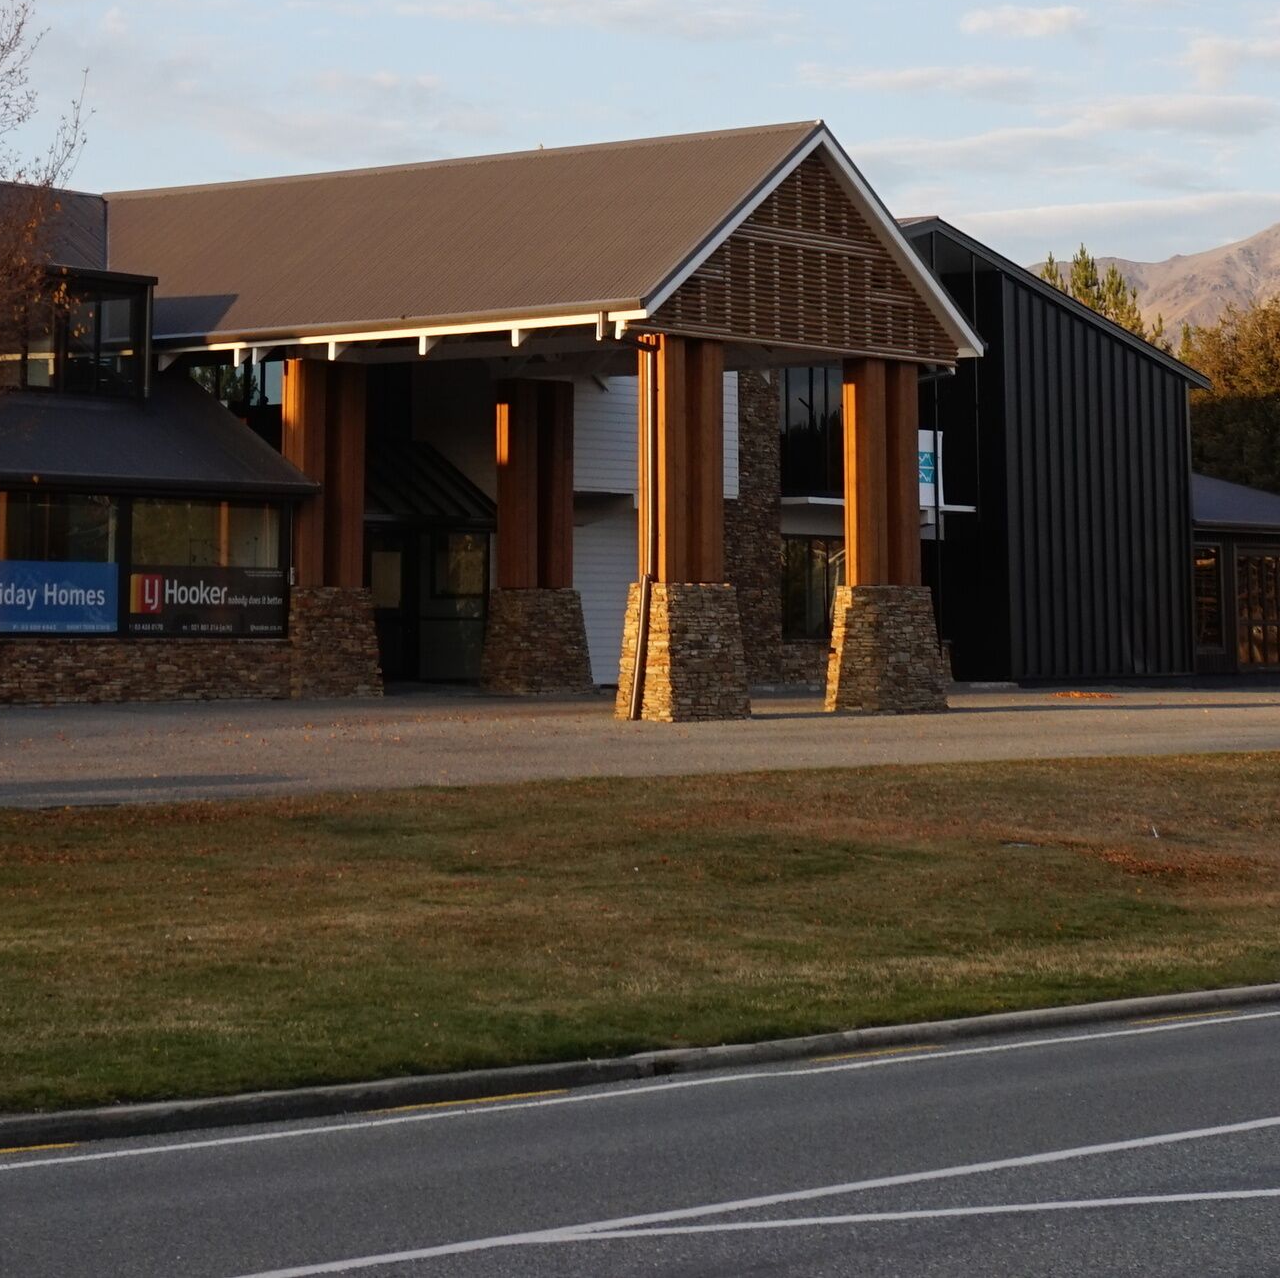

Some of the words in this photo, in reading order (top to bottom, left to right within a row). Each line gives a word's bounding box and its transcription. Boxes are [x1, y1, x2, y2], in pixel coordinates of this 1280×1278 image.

[44, 582, 105, 606] Homes
[144, 578, 159, 611] LJ
[165, 578, 228, 605] Hooker
